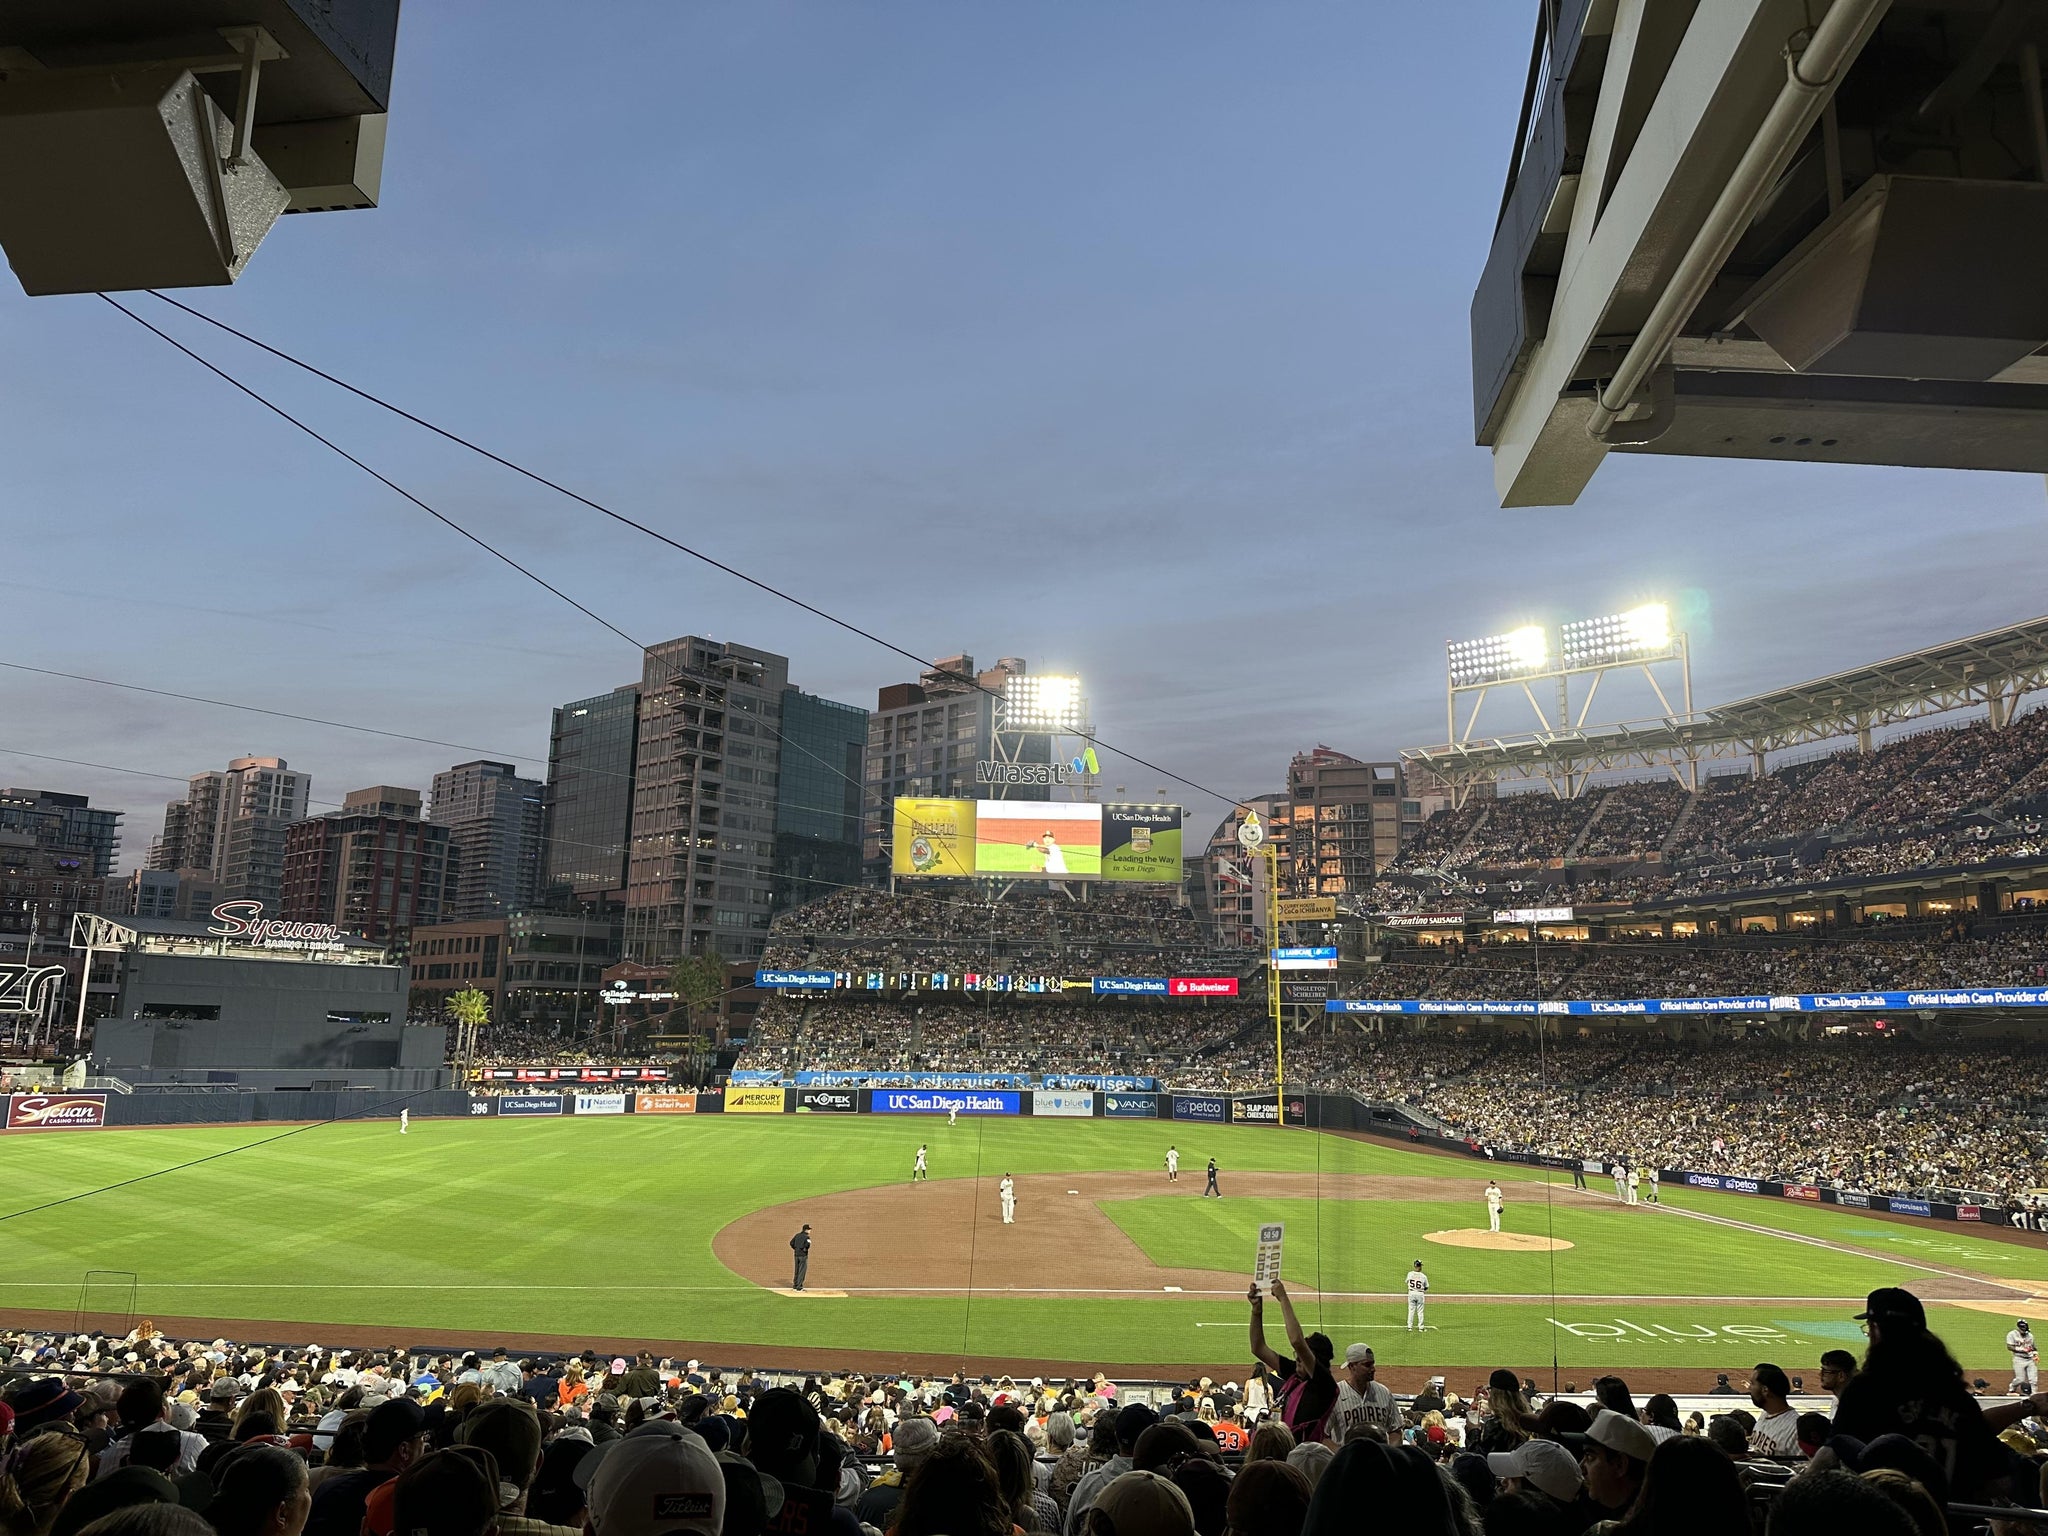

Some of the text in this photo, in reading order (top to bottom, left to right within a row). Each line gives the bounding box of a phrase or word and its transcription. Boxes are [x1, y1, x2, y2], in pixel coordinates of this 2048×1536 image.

[980, 761, 1065, 784] Viasat
[1135, 814, 1151, 822] Diego
[1113, 855, 1143, 863] Leading
[1159, 856, 1174, 864] Way
[1137, 865, 1155, 873] Diego
[207, 900, 340, 946] Sycuan
[1386, 915, 1463, 925] Tarantino SAUSAGES
[264, 939, 345, 950] CASINO RESORT
[763, 974, 830, 984] UC San Diego Health
[857, 976, 862, 985] F
[890, 977, 895, 985] F
[922, 977, 927, 986] F
[955, 978, 960, 986] F
[1100, 981, 1165, 991] UC San Diego Health
[1190, 983, 1230, 991] Budweiser
[599, 989, 637, 999] Gallagher
[1907, 991, 2048, 1005] Official Health Care Provider of
[604, 997, 631, 1005] Square
[1660, 996, 1801, 1011] Official Health Care Provider of the PADRES
[1860, 996, 1886, 1006] Health
[1382, 1003, 1402, 1011] Health
[1419, 1002, 1569, 1014] Official Health Care Provider of the PADRES
[1628, 1003, 1645, 1011] Health
[804, 1093, 850, 1105] EVOTEK
[889, 1095, 1003, 1112] UC San Diego Health
[1035, 1099, 1082, 1107] blue blue
[471, 1103, 488, 1114] 396
[1118, 1100, 1155, 1109] VANDA
[1189, 1101, 1220, 1113] petco
[1246, 1104, 1261, 1112] SLAP
[16, 1098, 94, 1125] Sycuan
[1698, 1175, 1757, 1190] petco petco
[1891, 1202, 1923, 1210] citycruises
[1409, 1280, 1422, 1289] 56
[1545, 1317, 1787, 1338] blue
[1587, 1337, 1813, 1345] CALIFORNIA
[1344, 1406, 1388, 1426] PADRES
[1217, 1431, 1239, 1449] 23
[1751, 1430, 1777, 1456] DRES
[658, 1497, 710, 1515] Titleist
